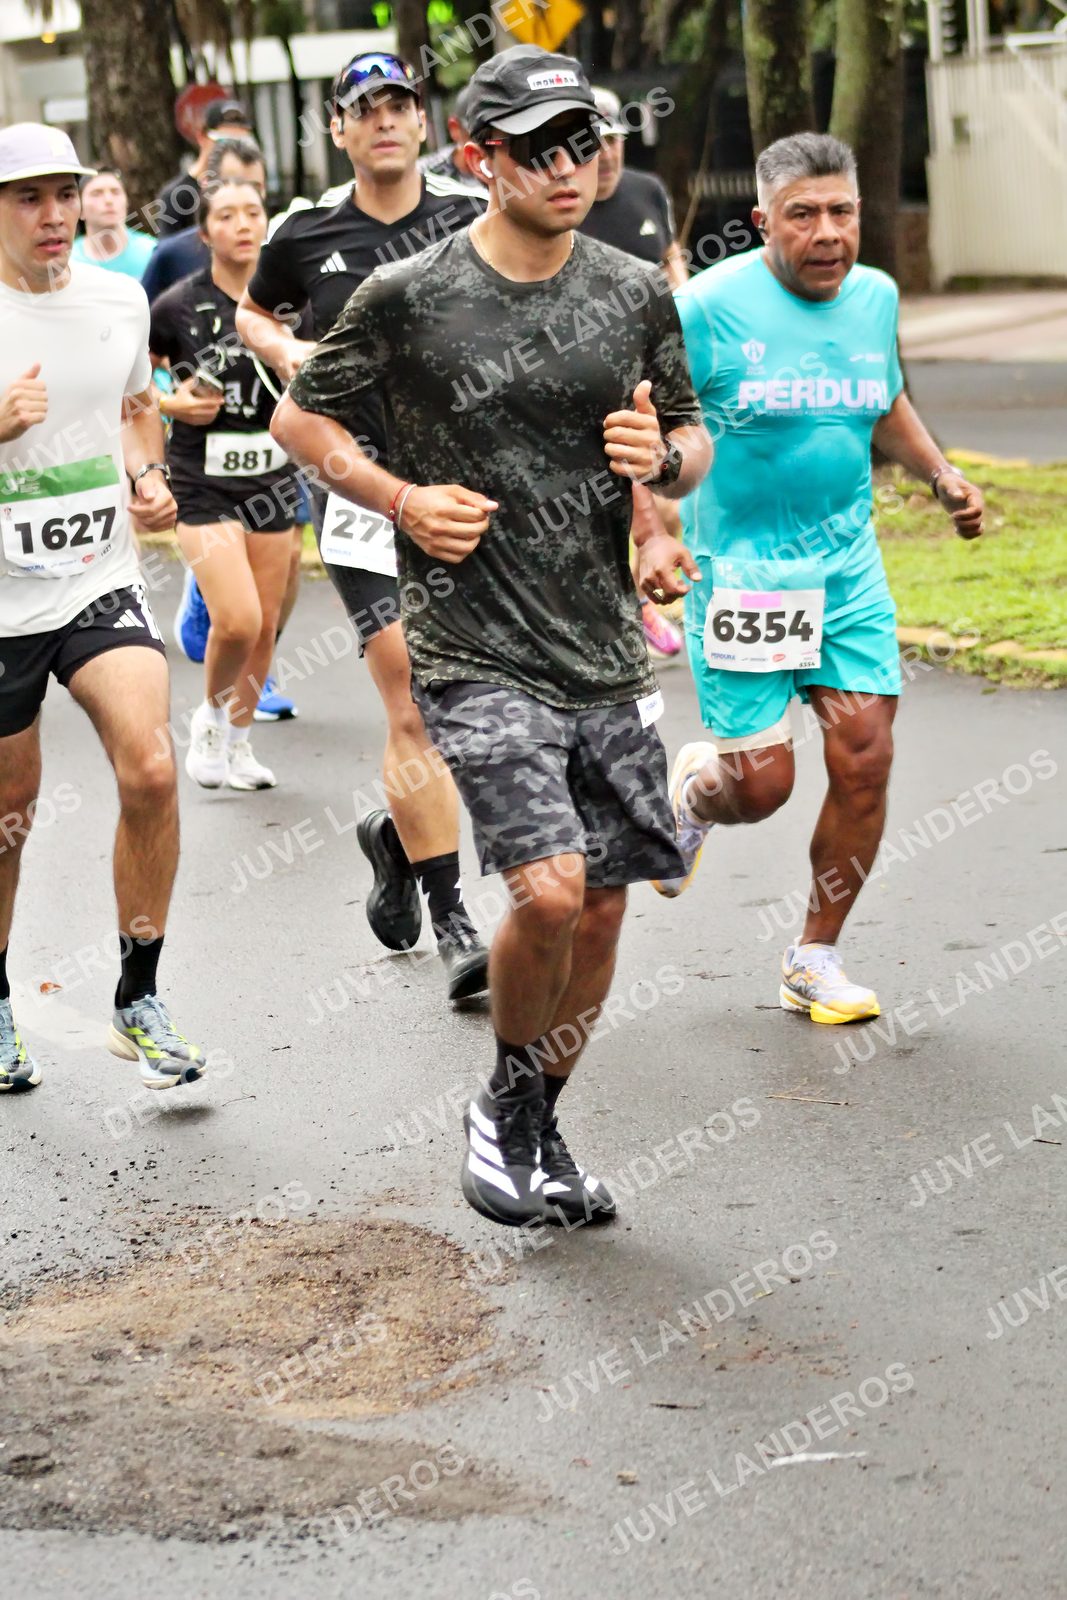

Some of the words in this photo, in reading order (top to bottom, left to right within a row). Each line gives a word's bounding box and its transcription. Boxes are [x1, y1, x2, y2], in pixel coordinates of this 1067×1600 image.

[738, 378, 888, 410] PERDUR
[223, 449, 273, 471] 881
[14, 506, 116, 555] 1627
[713, 609, 813, 644] 6354
